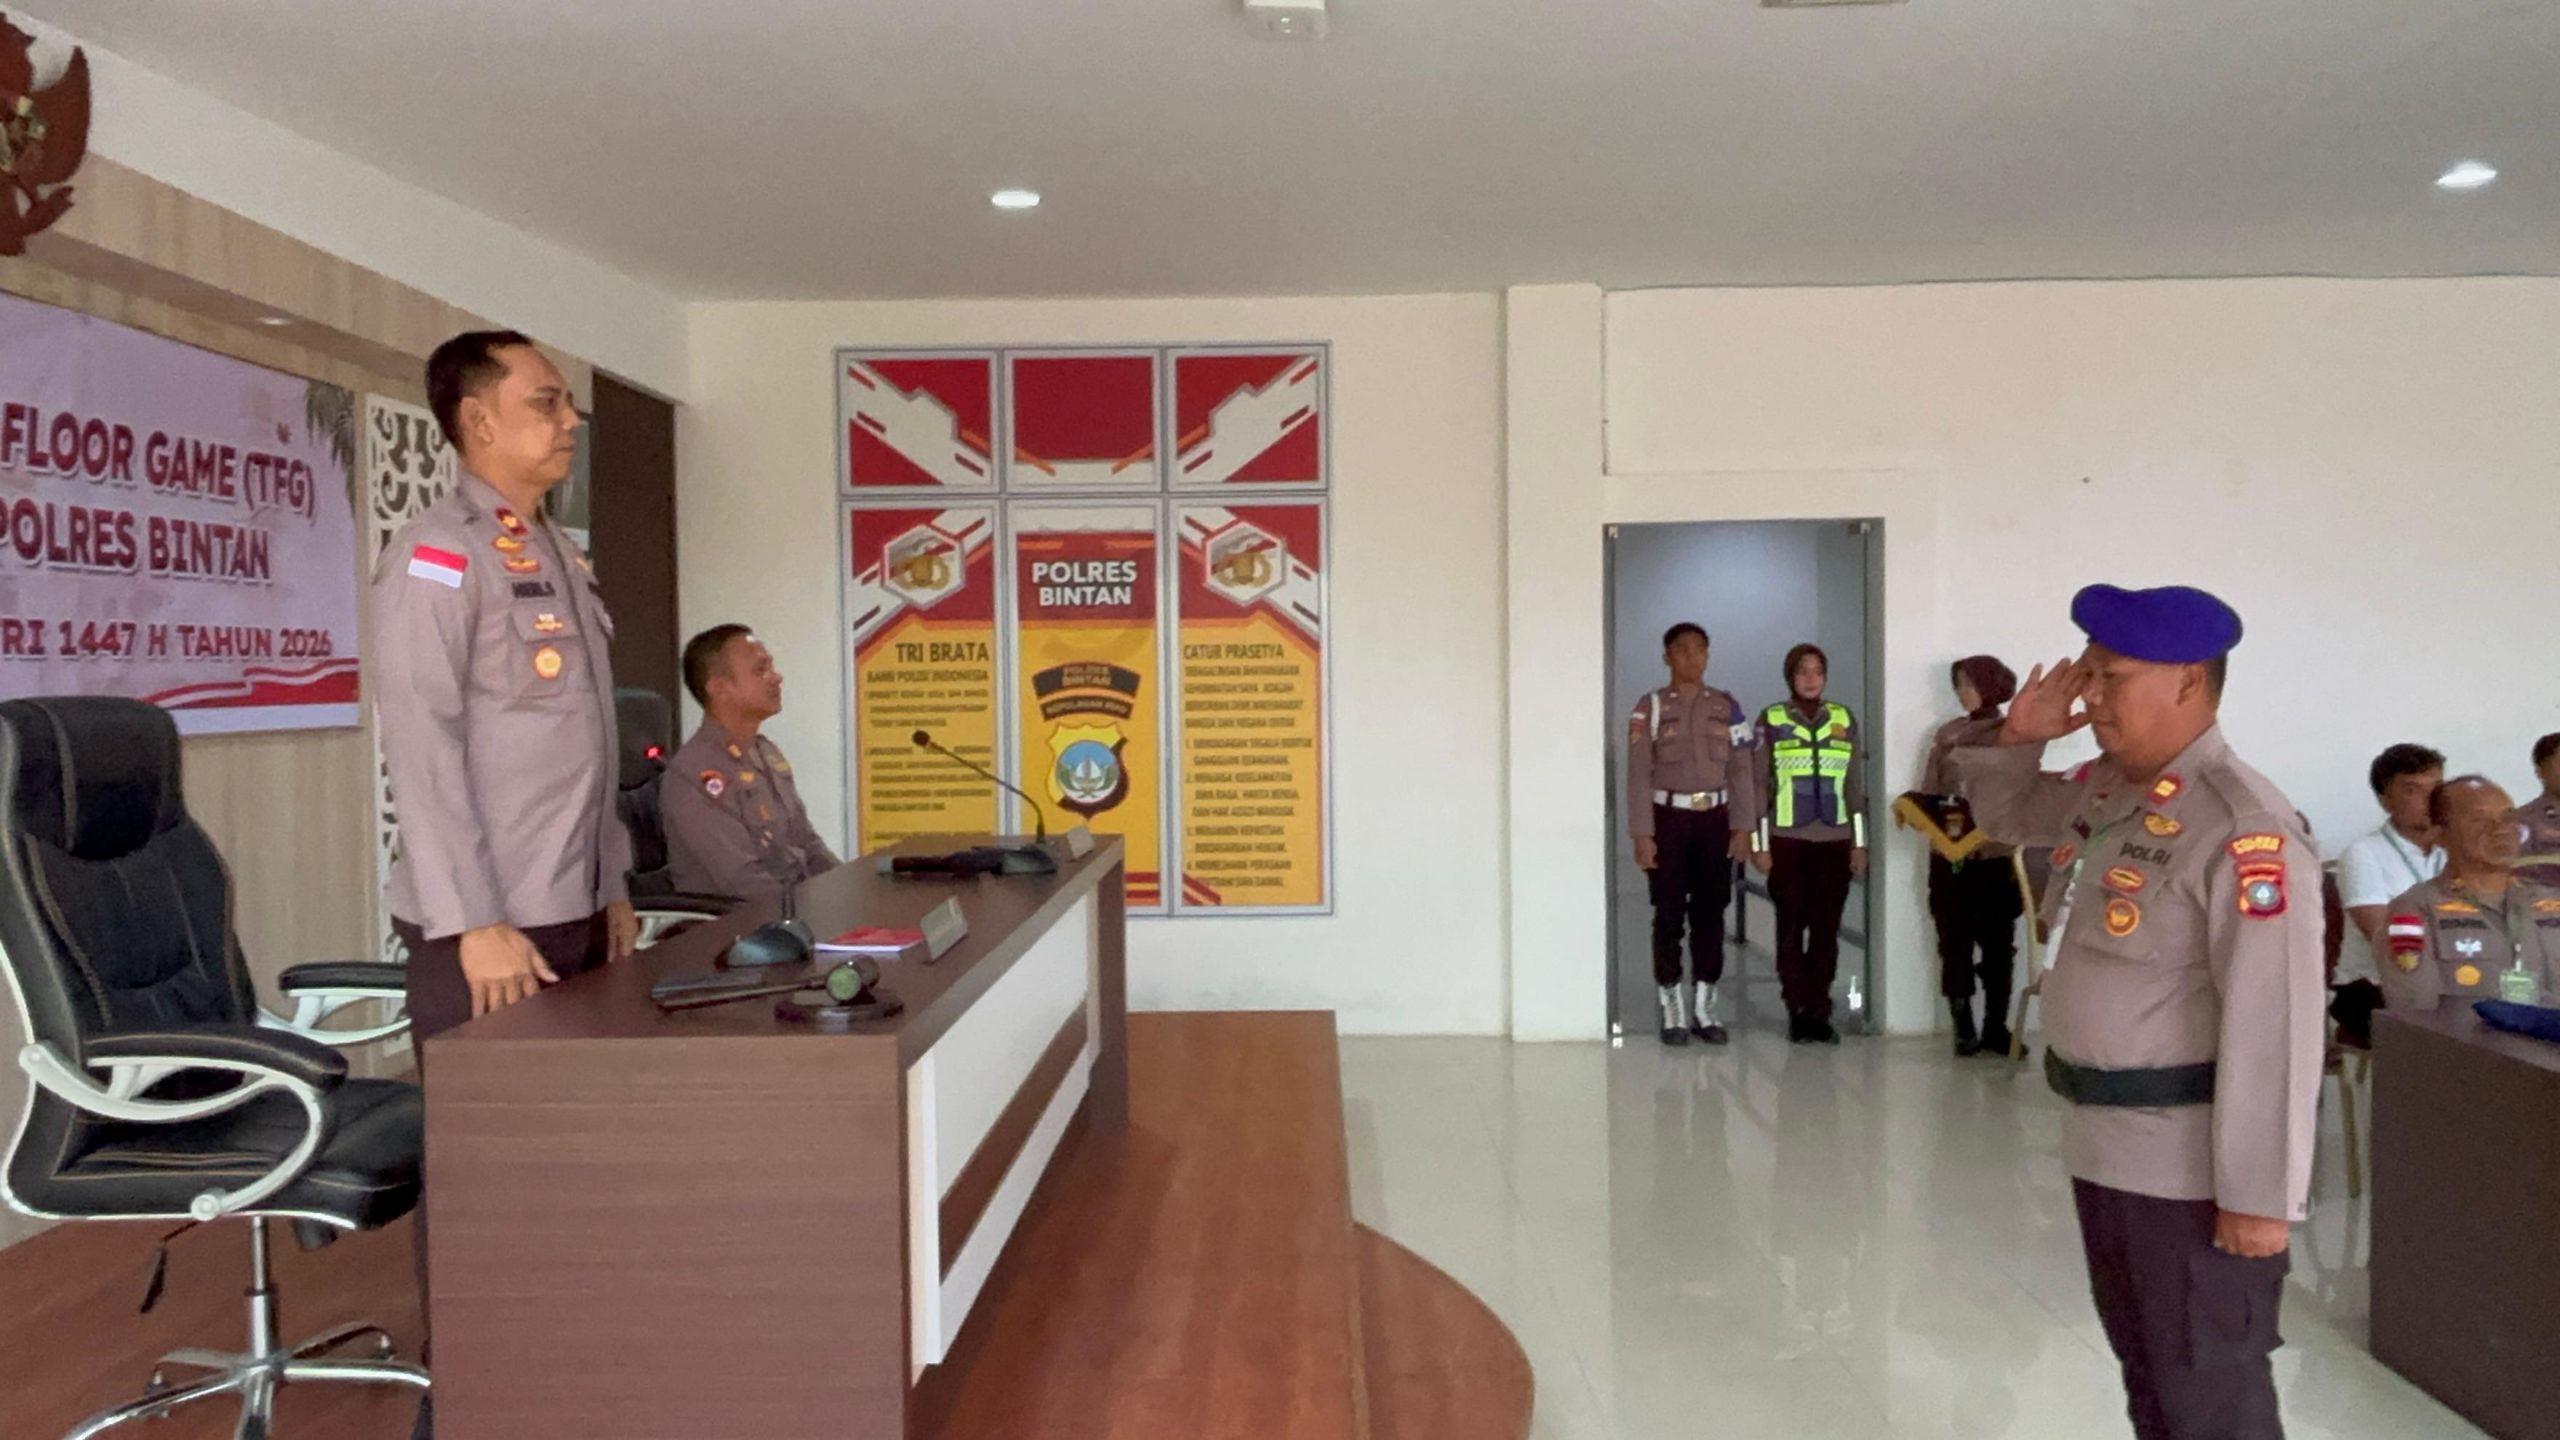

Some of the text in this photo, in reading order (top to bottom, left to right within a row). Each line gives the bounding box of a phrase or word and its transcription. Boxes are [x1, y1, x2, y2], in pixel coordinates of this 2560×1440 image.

[1, 402, 314, 519] FLOOR GAME (TFG)
[149, 516, 270, 579] BINTAN
[1032, 561, 1138, 584] POLRES
[1039, 586, 1132, 606] BINTAN
[60, 622, 136, 656] 1447
[148, 625, 167, 656] H
[177, 625, 272, 657] TAHUN
[280, 628, 333, 657] 2026
[1183, 643, 1285, 660] CATUR PRASETYA
[895, 642, 990, 663] TRI BRATA
[2120, 841, 2172, 866] POLRI
